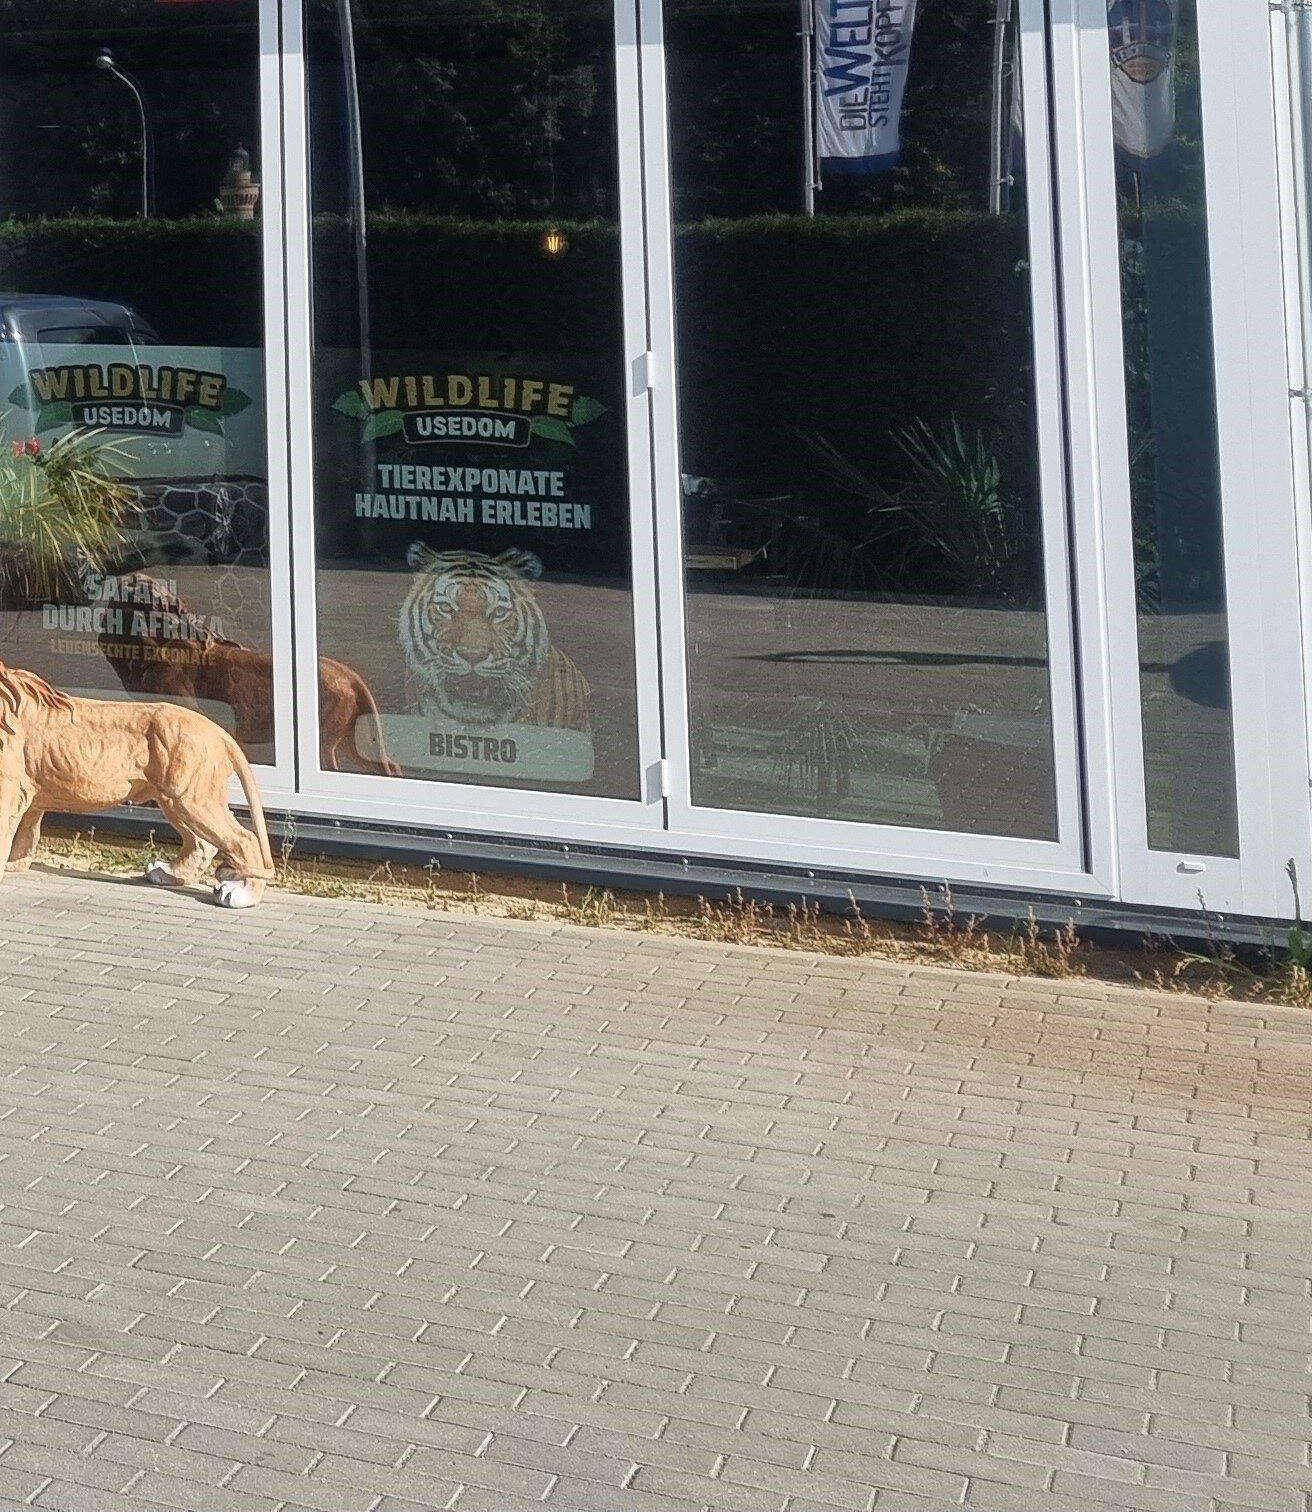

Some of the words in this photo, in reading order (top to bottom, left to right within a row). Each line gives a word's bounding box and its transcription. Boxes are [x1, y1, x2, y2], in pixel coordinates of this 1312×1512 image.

[840, 88, 869, 131] DIE
[868, 70, 891, 127] STEHT
[32, 362, 224, 407] WILDLIFE
[359, 375, 574, 416] WILDLIFE
[83, 407, 172, 429] USEDOM
[416, 416, 516, 439] USEDOM
[377, 464, 565, 496] TIEREXPONATE
[355, 493, 475, 524] HAUTNAH
[481, 499, 592, 529] ERLEBEN
[42, 603, 124, 634] DURCH
[130, 610, 224, 642] AFRIKA
[429, 732, 517, 763] BISTRO
